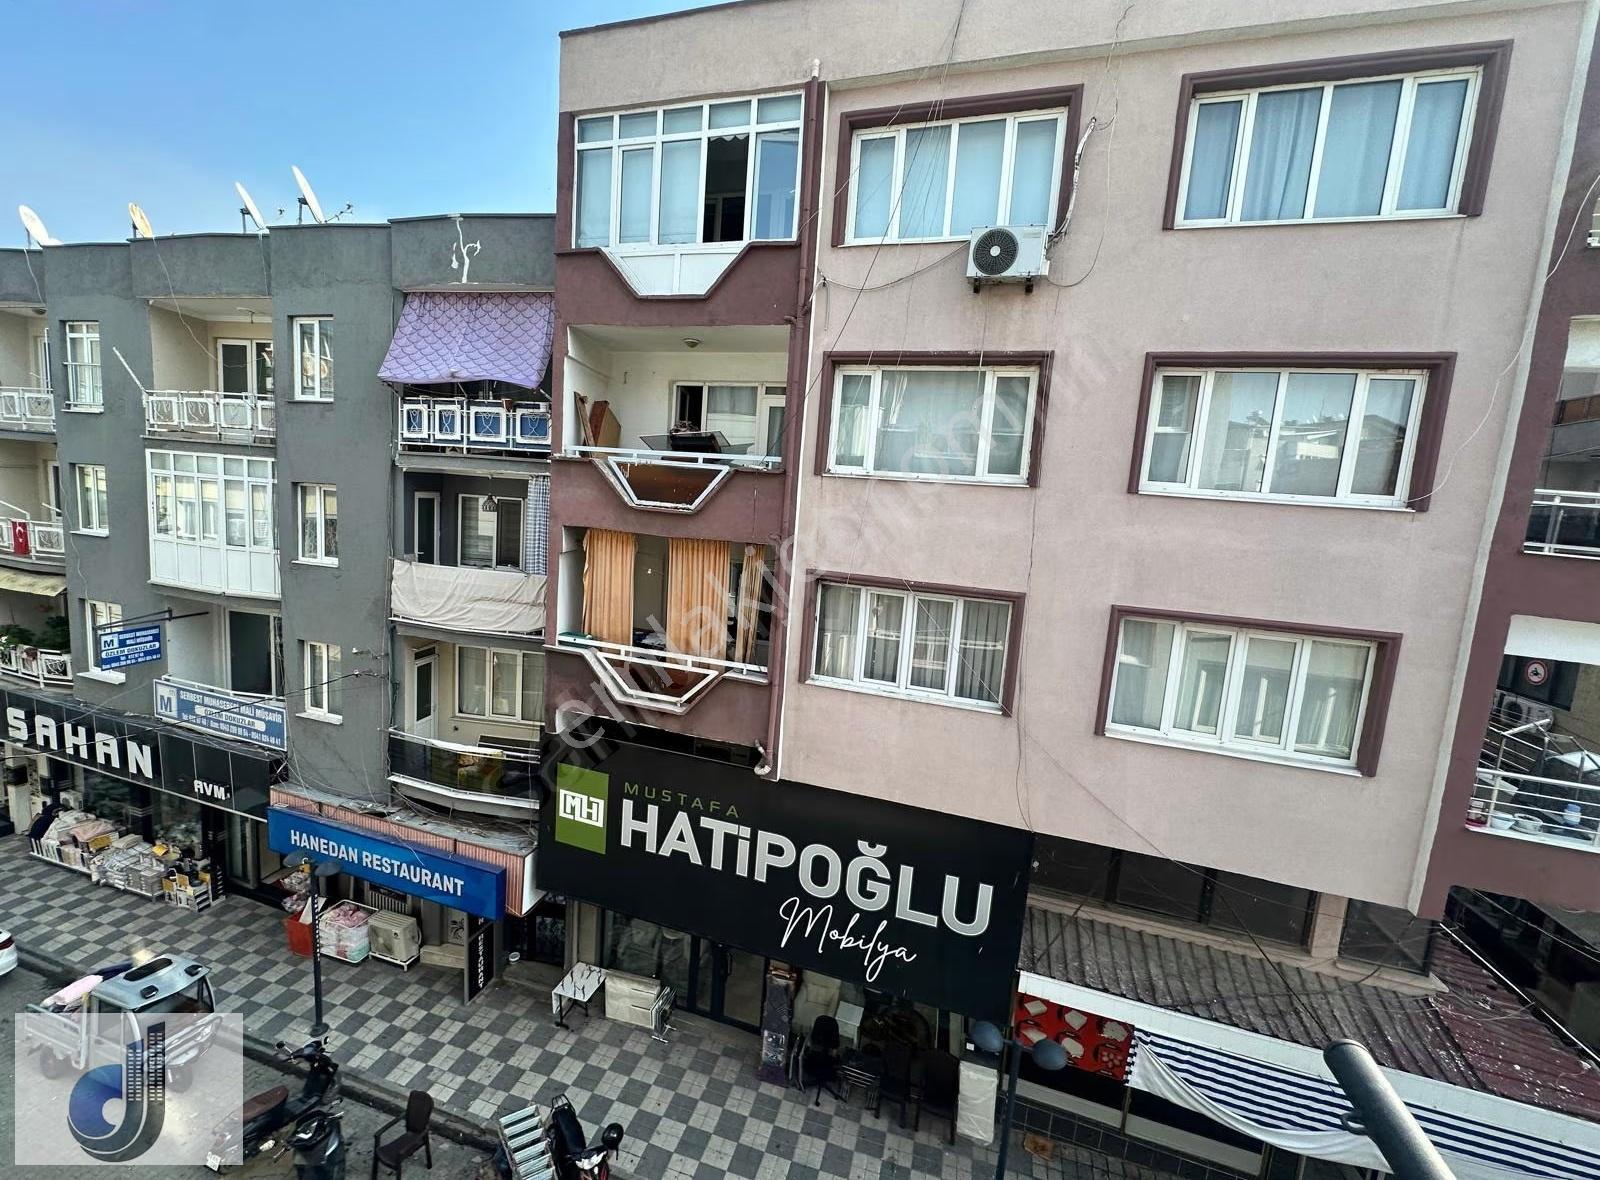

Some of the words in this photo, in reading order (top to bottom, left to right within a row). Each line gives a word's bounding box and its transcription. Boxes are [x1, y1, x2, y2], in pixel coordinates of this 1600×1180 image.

[103, 639, 114, 648] M
[160, 695, 172, 713] M
[224, 713, 256, 728] DOKUZLAR
[624, 782, 739, 818] MUSTAFA
[290, 829, 358, 864] HANEDAN
[362, 852, 465, 896] RESTAURANT
[779, 896, 917, 983] Mobilya
